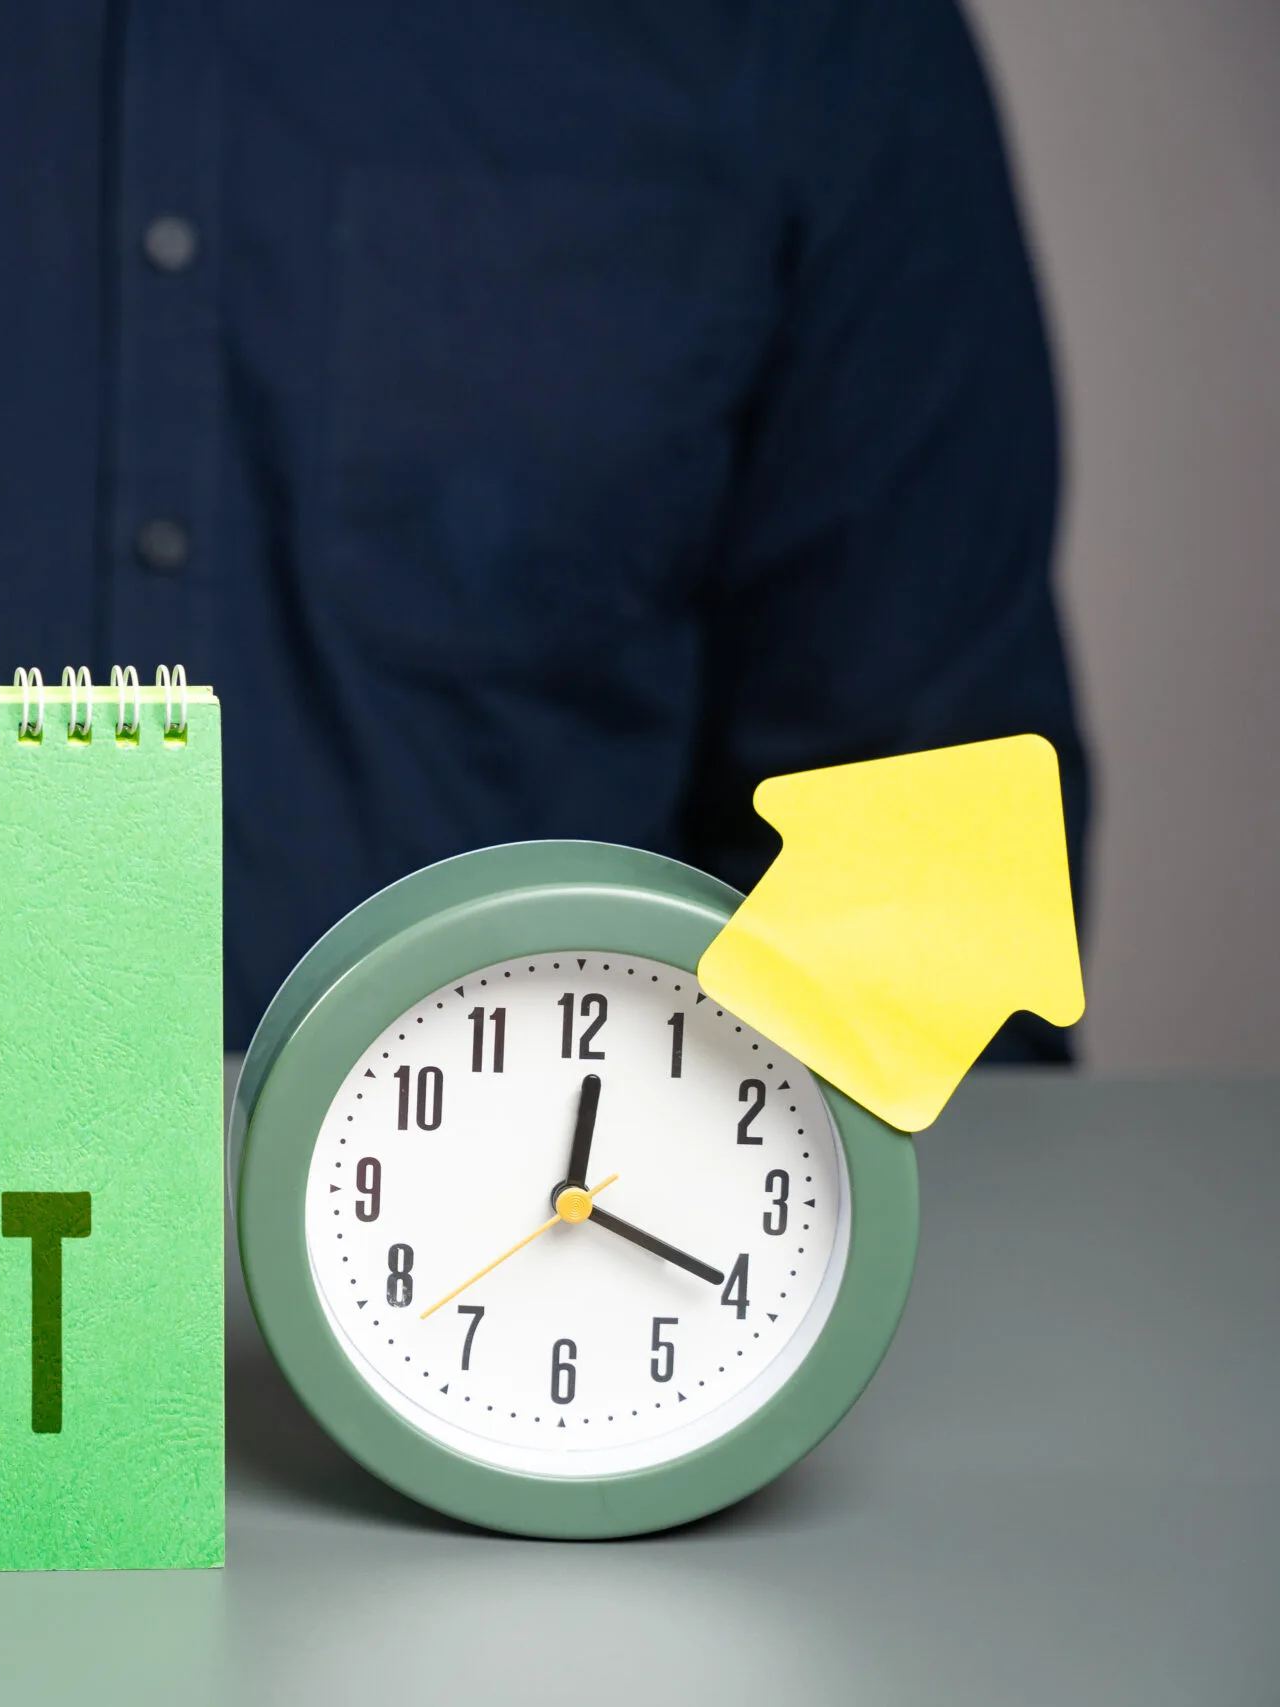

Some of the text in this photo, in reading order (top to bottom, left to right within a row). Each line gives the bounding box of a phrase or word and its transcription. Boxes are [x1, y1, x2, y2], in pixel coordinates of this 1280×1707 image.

[467, 1006, 506, 1073] 11
[557, 992, 608, 1060] 12
[667, 1012, 685, 1078] 1
[393, 1065, 444, 1131] 10
[736, 1078, 767, 1146] 2
[355, 1156, 382, 1223] 9
[763, 1169, 790, 1236] 3
[386, 1243, 414, 1308] 8
[721, 1253, 750, 1320] 4
[457, 1304, 485, 1371] 7
[650, 1316, 679, 1383] 5
[550, 1338, 577, 1405] 6
